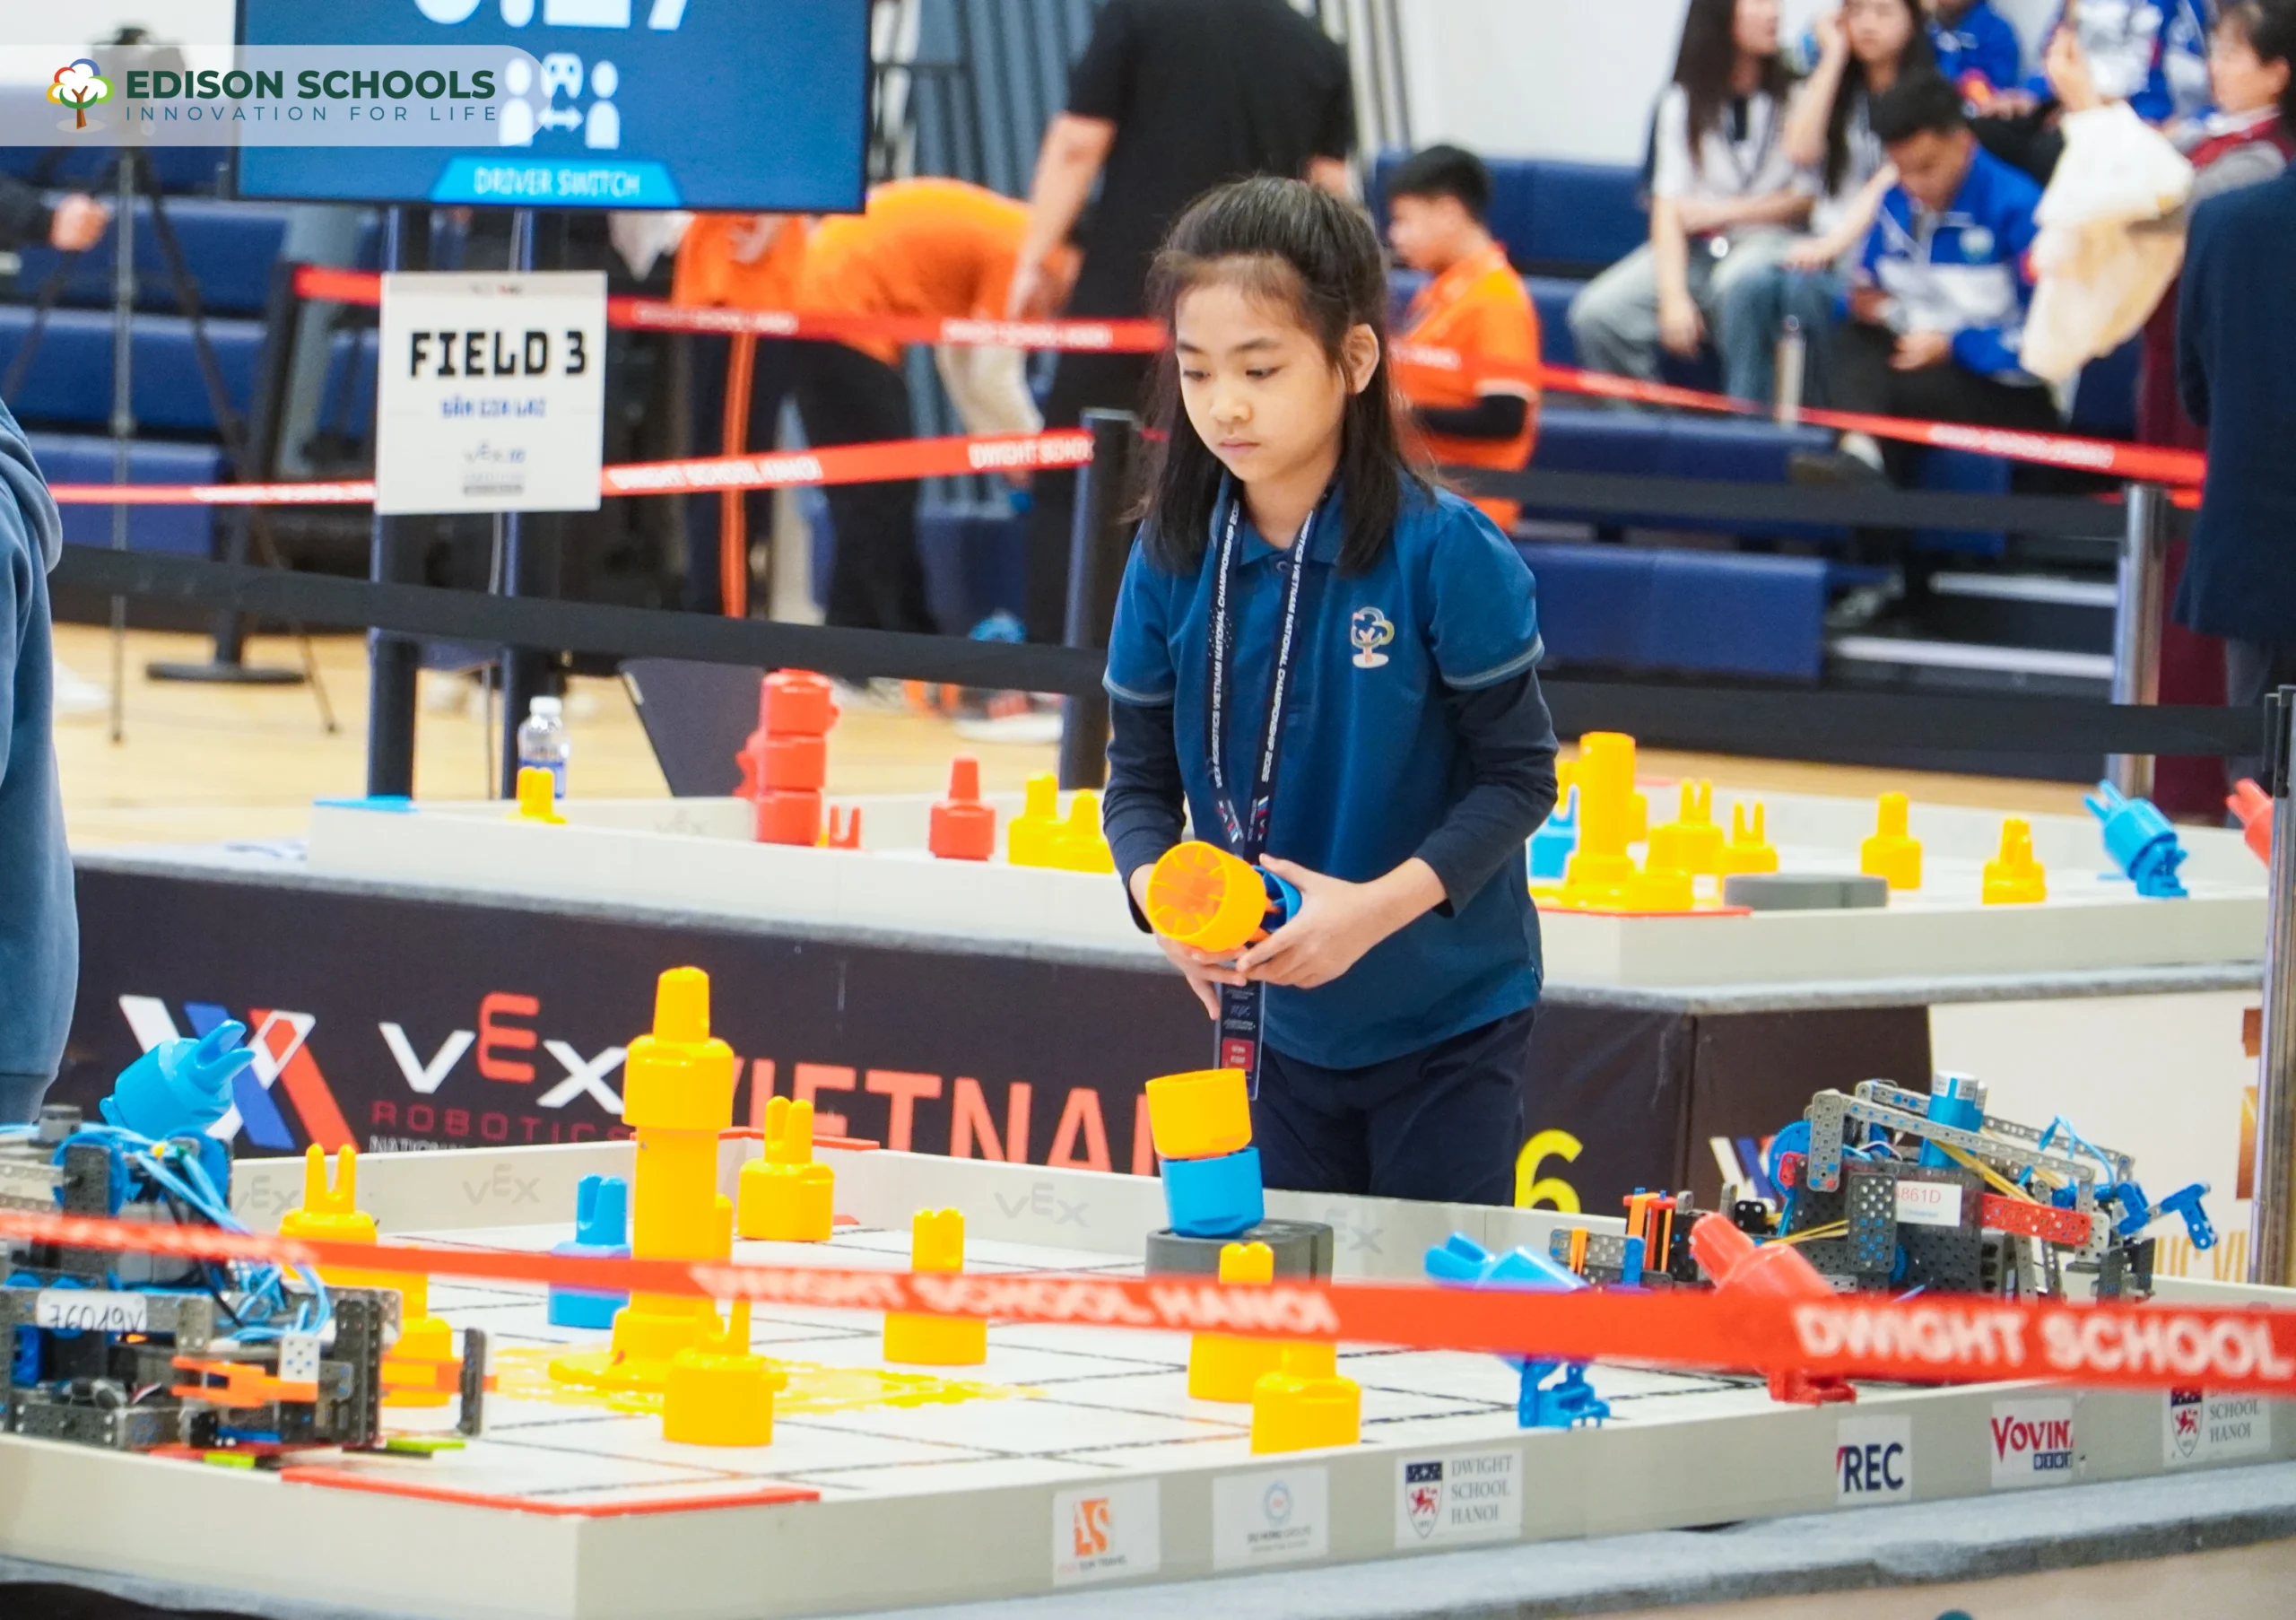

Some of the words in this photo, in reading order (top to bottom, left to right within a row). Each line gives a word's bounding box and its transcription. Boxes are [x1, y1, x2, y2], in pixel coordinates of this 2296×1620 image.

[474, 167, 552, 196] DRIVER
[556, 169, 640, 197] SWITCH
[410, 330, 549, 378] FIELD
[565, 330, 587, 375] 3
[1217, 525, 1235, 608] CHAMPIONSHIP
[1266, 668, 1286, 752] CHAMPIONSHIP
[378, 991, 628, 1115] VEX
[732, 1056, 1157, 1178] IETNA
[462, 1163, 540, 1206] VEX
[994, 1181, 1090, 1229] VEX
[1324, 1206, 1383, 1255] EX
[688, 1265, 906, 1308] DWIGHT
[910, 1275, 1154, 1323] SCHOOL
[1150, 1285, 1340, 1334] HANOI
[1796, 1306, 2025, 1364] DWIGHT
[2038, 1312, 2295, 1379] SCHOOL
[2210, 1399, 2261, 1420] SCHOOL
[2210, 1423, 2252, 1443] HANOI
[1991, 1415, 2074, 1463] VOVIN
[1451, 1455, 1513, 1476] DWIGHT
[1843, 1442, 1904, 1493] REC
[1451, 1479, 1510, 1501] SCHOOL
[1451, 1504, 1499, 1525] HANOI
